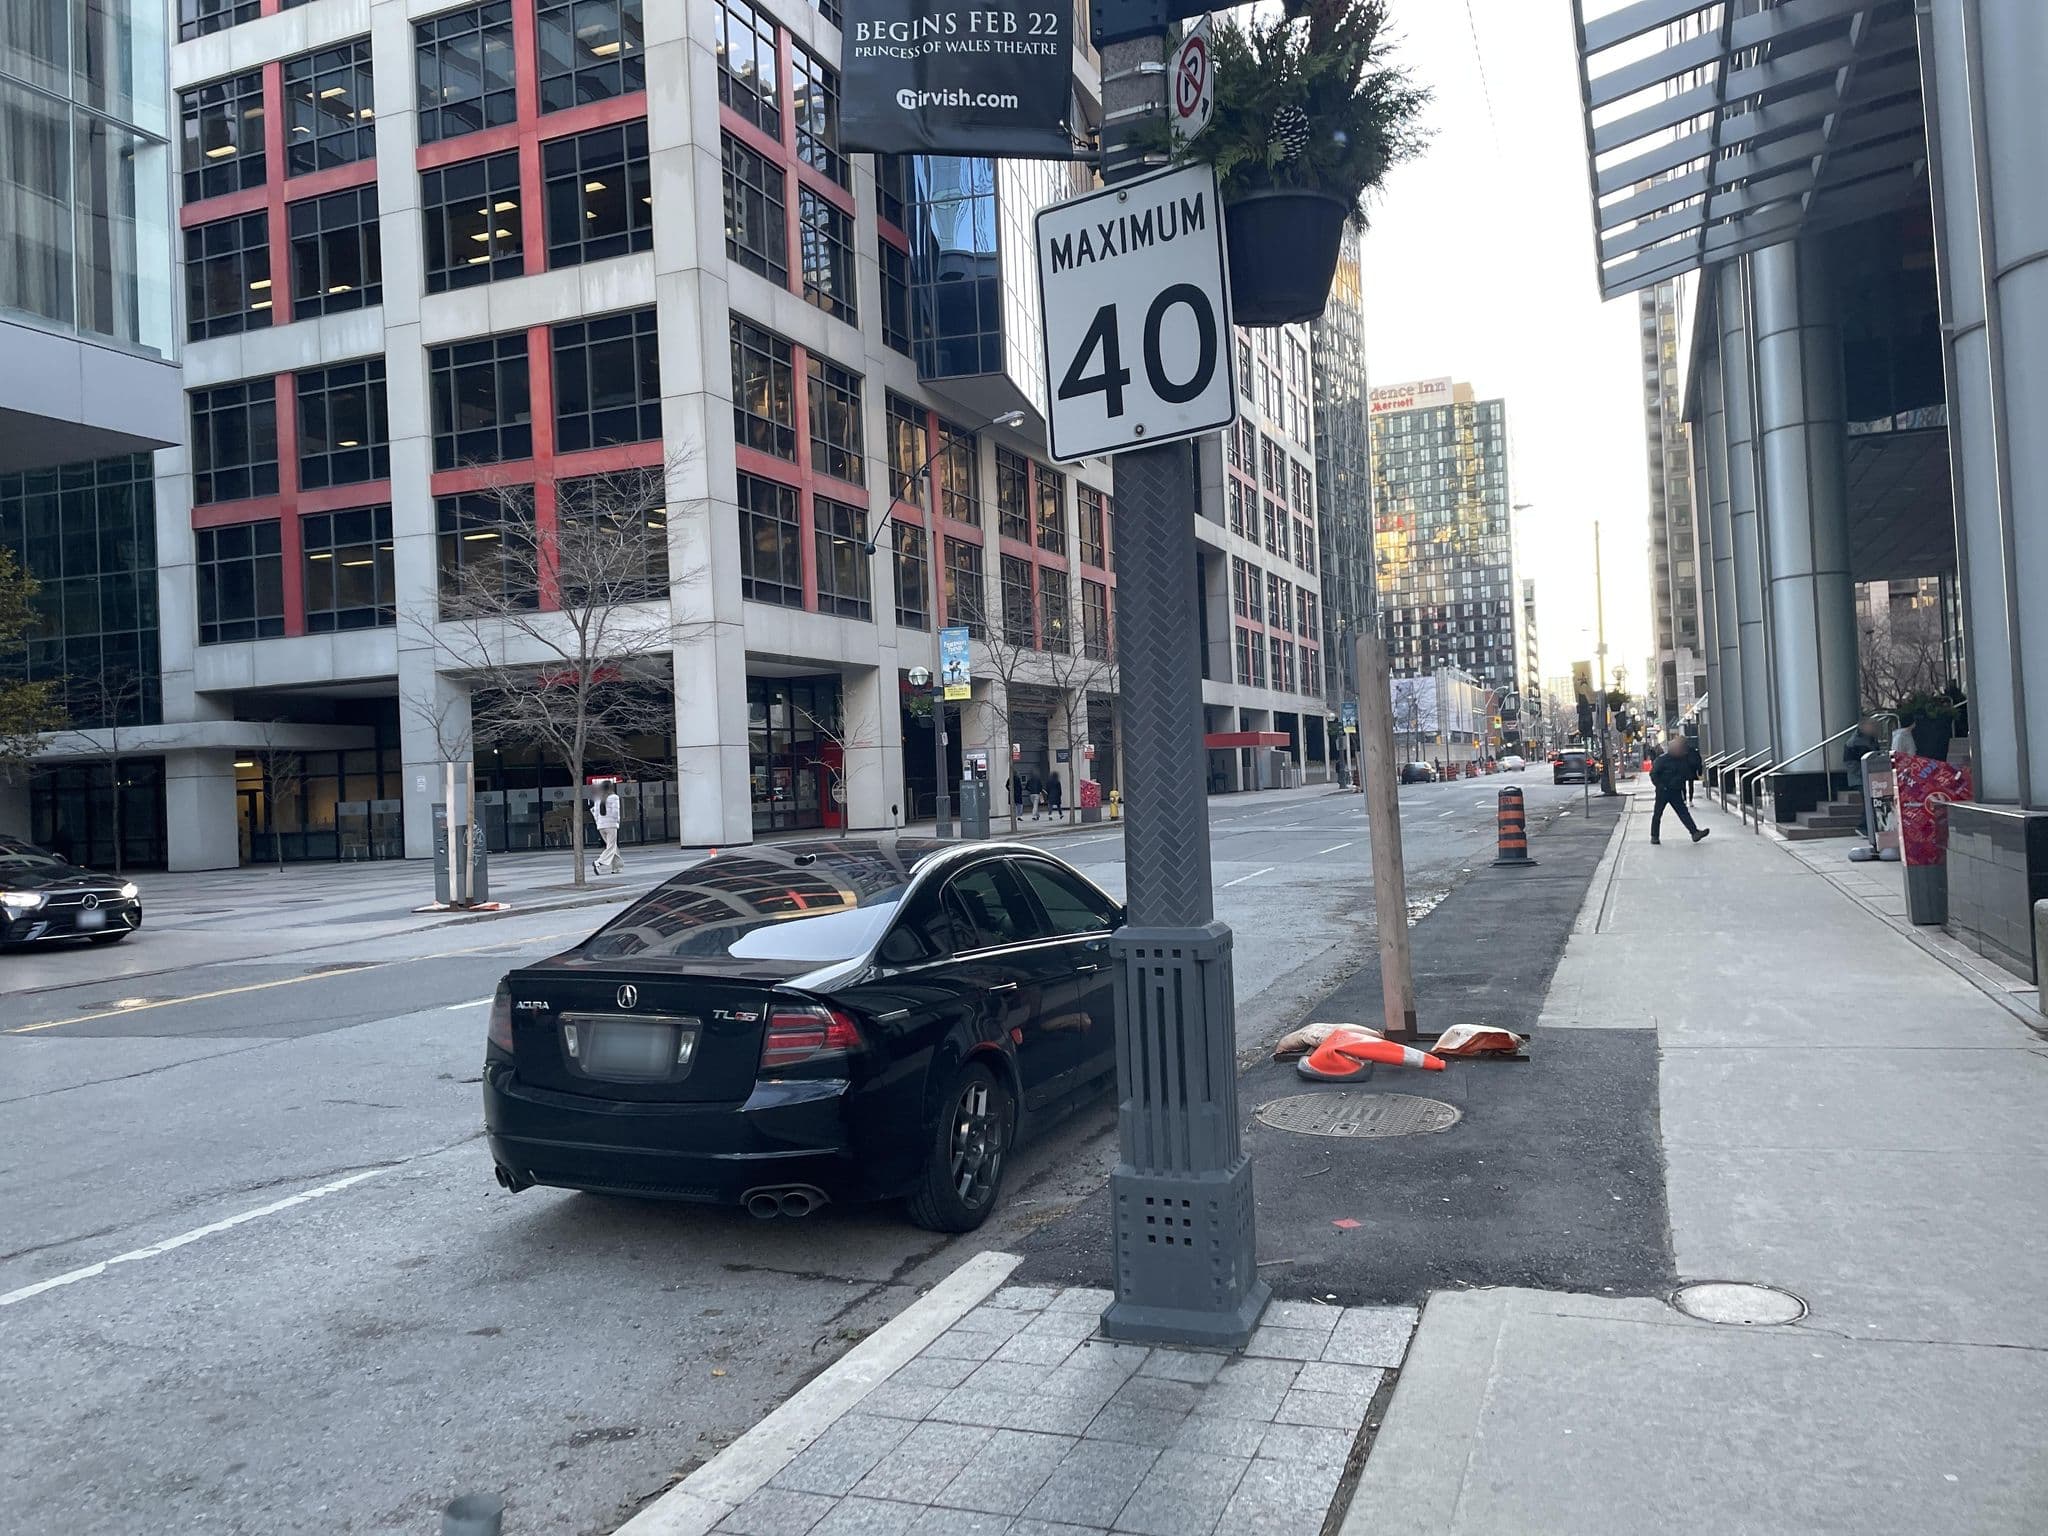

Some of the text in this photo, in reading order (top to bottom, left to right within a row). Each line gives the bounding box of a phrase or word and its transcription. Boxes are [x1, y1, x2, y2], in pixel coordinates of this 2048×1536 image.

[856, 11, 1059, 42] BEGINS FEB 22
[855, 40, 1058, 60] PRINCESS OF WALES THEATRE
[896, 88, 1018, 110] mirvish.com
[1050, 192, 1205, 274] MAXIMUM
[1058, 283, 1217, 418] 40
[1418, 381, 1446, 394] Inn
[516, 1001, 550, 1010] ACURA
